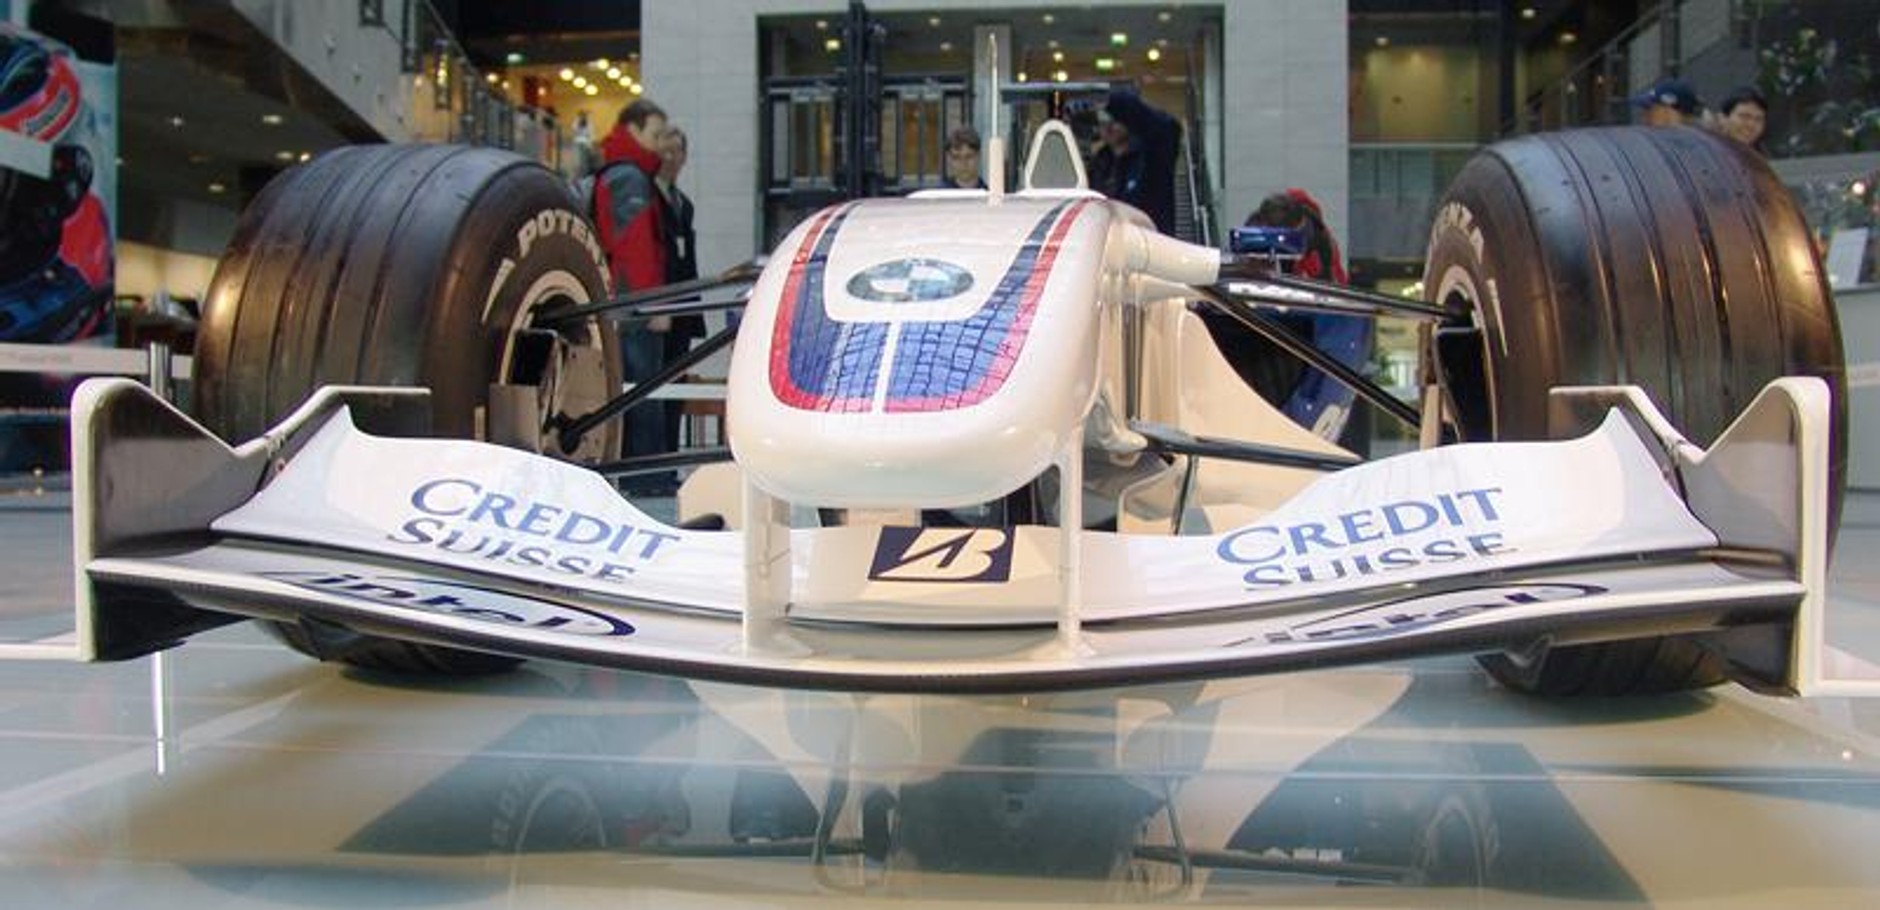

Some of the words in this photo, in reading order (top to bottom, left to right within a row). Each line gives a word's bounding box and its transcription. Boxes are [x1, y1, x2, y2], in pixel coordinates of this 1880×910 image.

[386, 517, 636, 583] SUISSE
[411, 479, 680, 560] CREDIT
[1216, 487, 1503, 564] CREDIT
[1242, 533, 1517, 591] SUISSE
